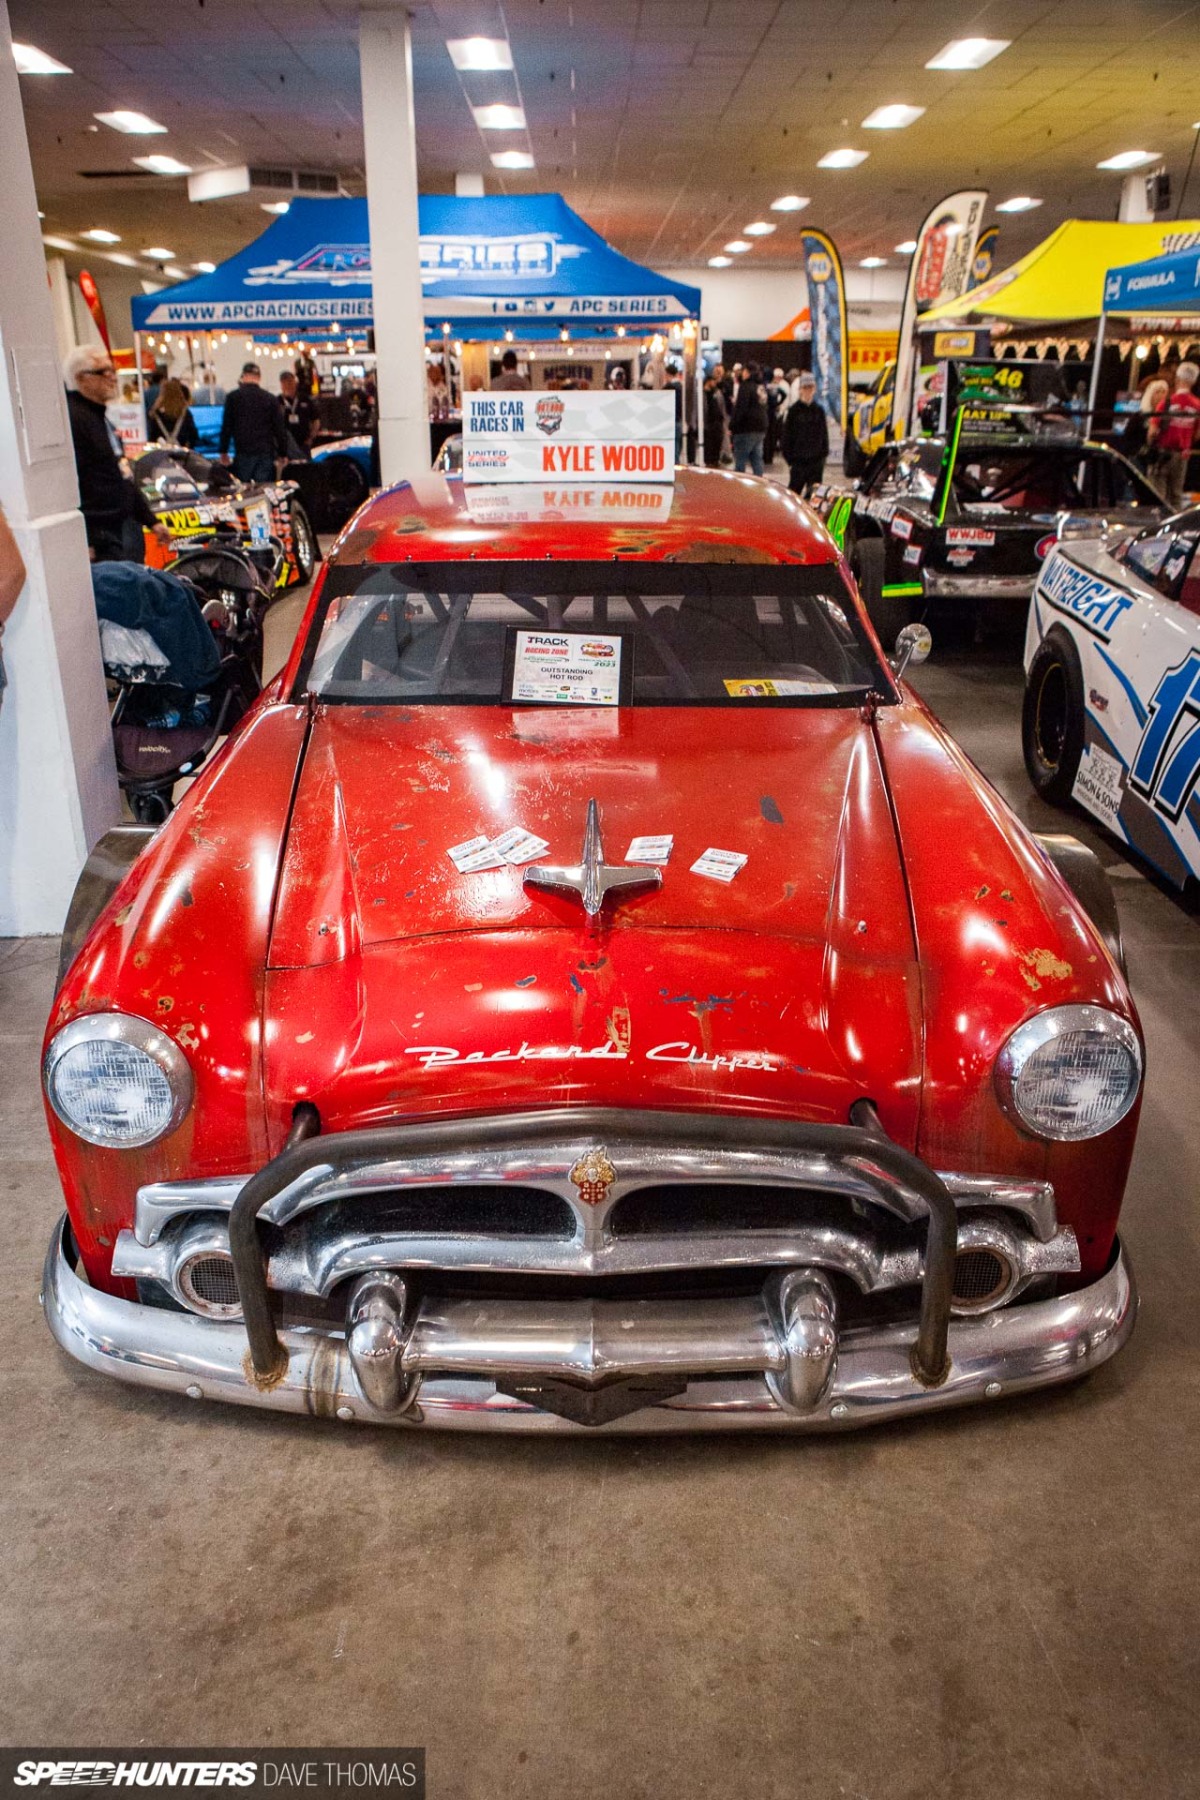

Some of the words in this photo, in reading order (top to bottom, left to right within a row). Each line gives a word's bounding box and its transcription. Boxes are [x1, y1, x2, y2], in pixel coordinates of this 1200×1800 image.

[570, 300, 603, 313] APC
[608, 299, 668, 313] SERIES
[471, 401, 497, 416] THIS
[500, 401, 525, 416] CAR
[470, 417, 508, 433] RACES
[512, 417, 525, 432] IN
[542, 445, 595, 472] KYLE
[602, 445, 665, 472] WOOD
[155, 505, 200, 531] TWO
[527, 636, 569, 647] TRACK
[541, 667, 593, 676] OUTSTANDING
[1077, 771, 1097, 795] SIMON
[1096, 787, 1102, 800] &
[1101, 791, 1120, 815] SONS
[404, 1041, 627, 1069] Packard
[646, 1041, 778, 1072] Clipper
